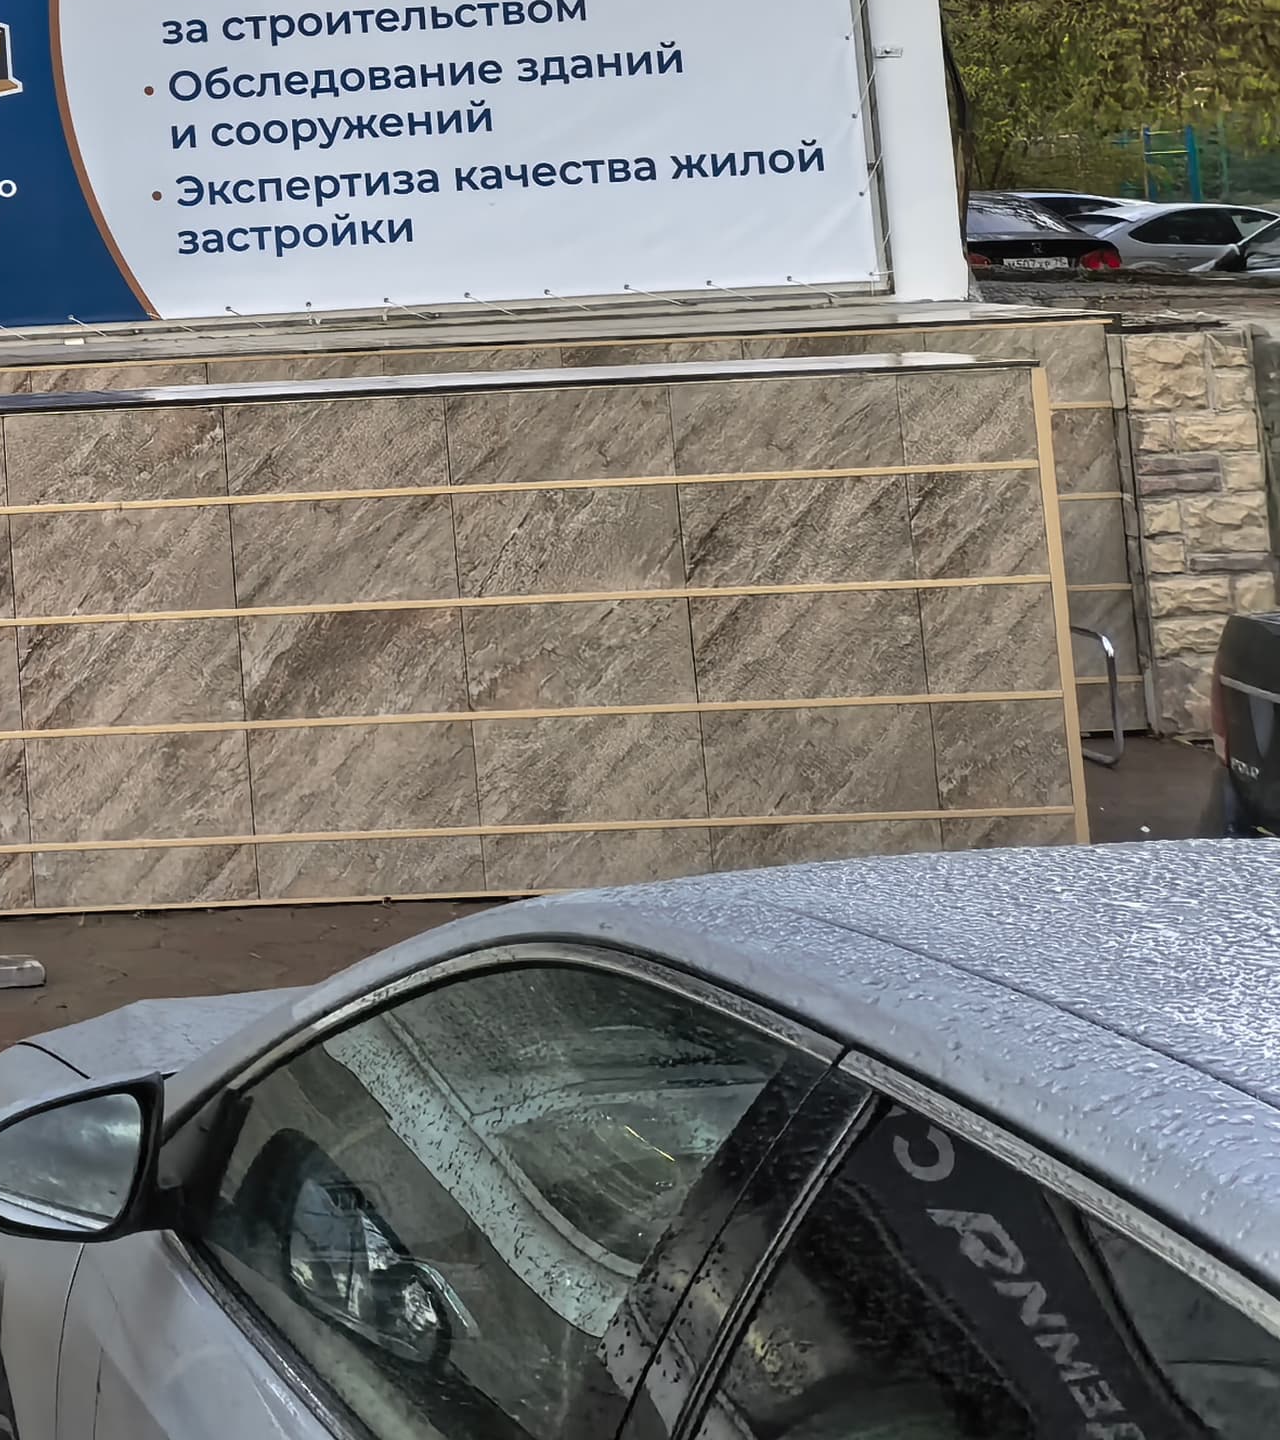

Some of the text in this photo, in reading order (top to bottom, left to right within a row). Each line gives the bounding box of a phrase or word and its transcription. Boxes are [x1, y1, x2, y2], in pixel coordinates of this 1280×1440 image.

[162, 17, 207, 45] за
[168, 42, 685, 103] Обследование зданий
[171, 101, 494, 151] и сооружений
[175, 140, 826, 208] Экспертиза качества жилой
[178, 213, 413, 257] застройки
